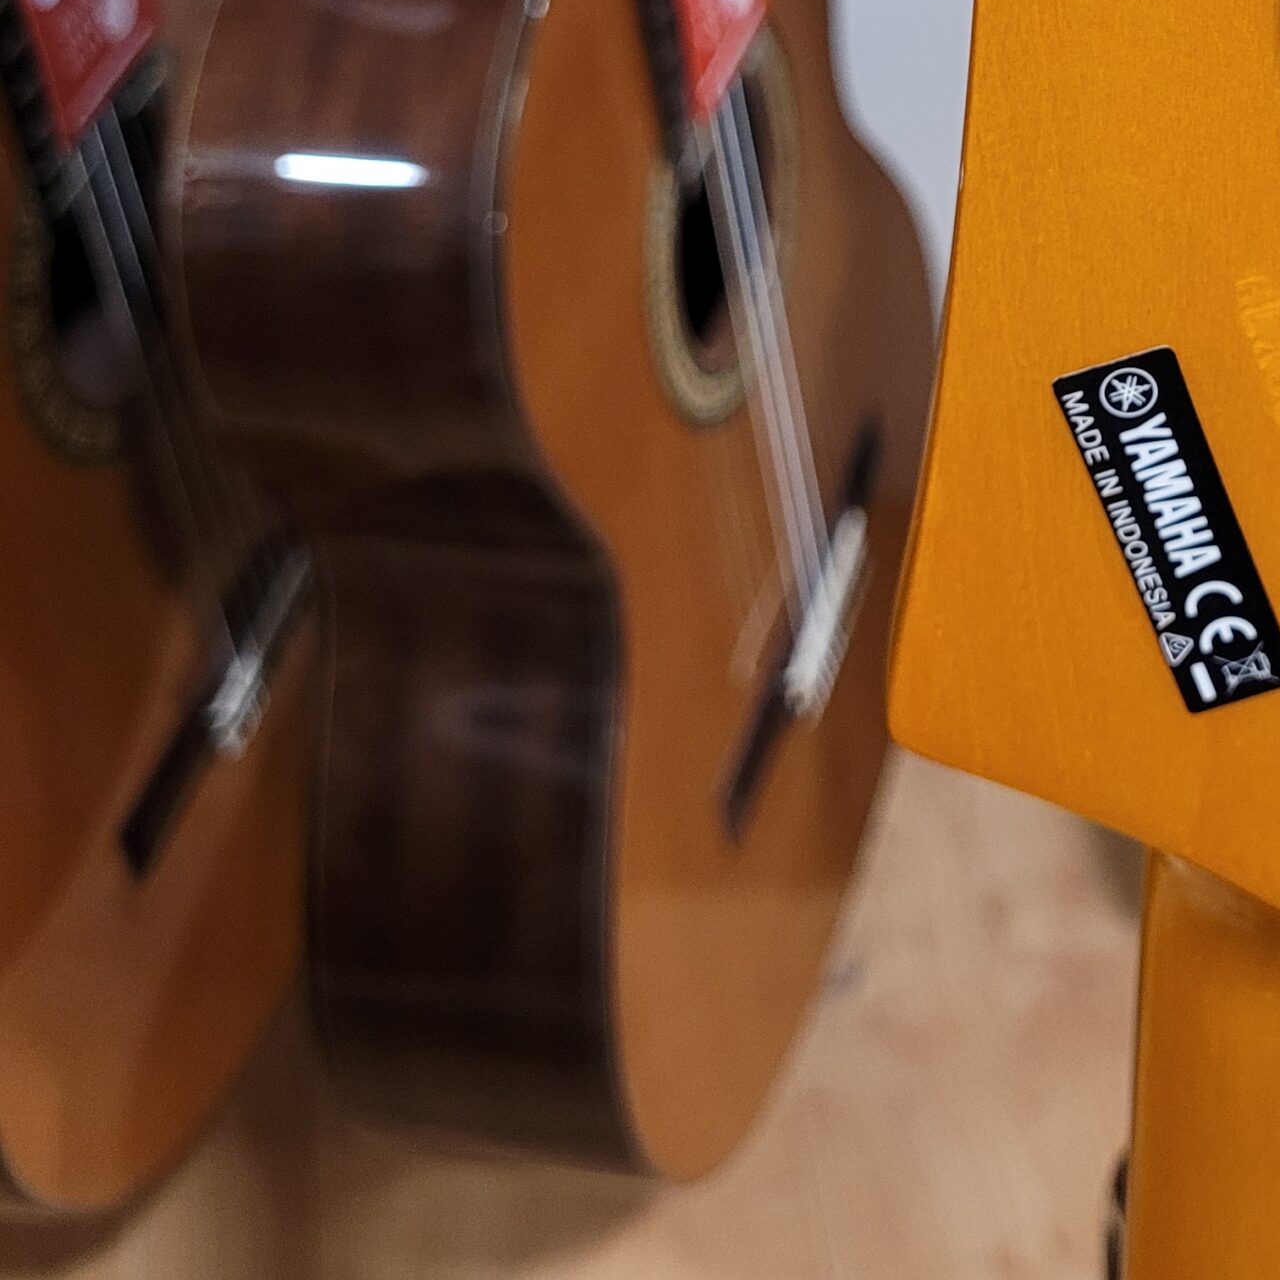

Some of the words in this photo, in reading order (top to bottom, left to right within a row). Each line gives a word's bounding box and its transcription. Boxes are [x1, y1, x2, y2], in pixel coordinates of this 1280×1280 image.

[1061, 390, 1110, 466] MADE
[1093, 468, 1124, 498] IN
[1118, 412, 1222, 579] YAMAHA
[1107, 499, 1177, 631] INDONESIA
